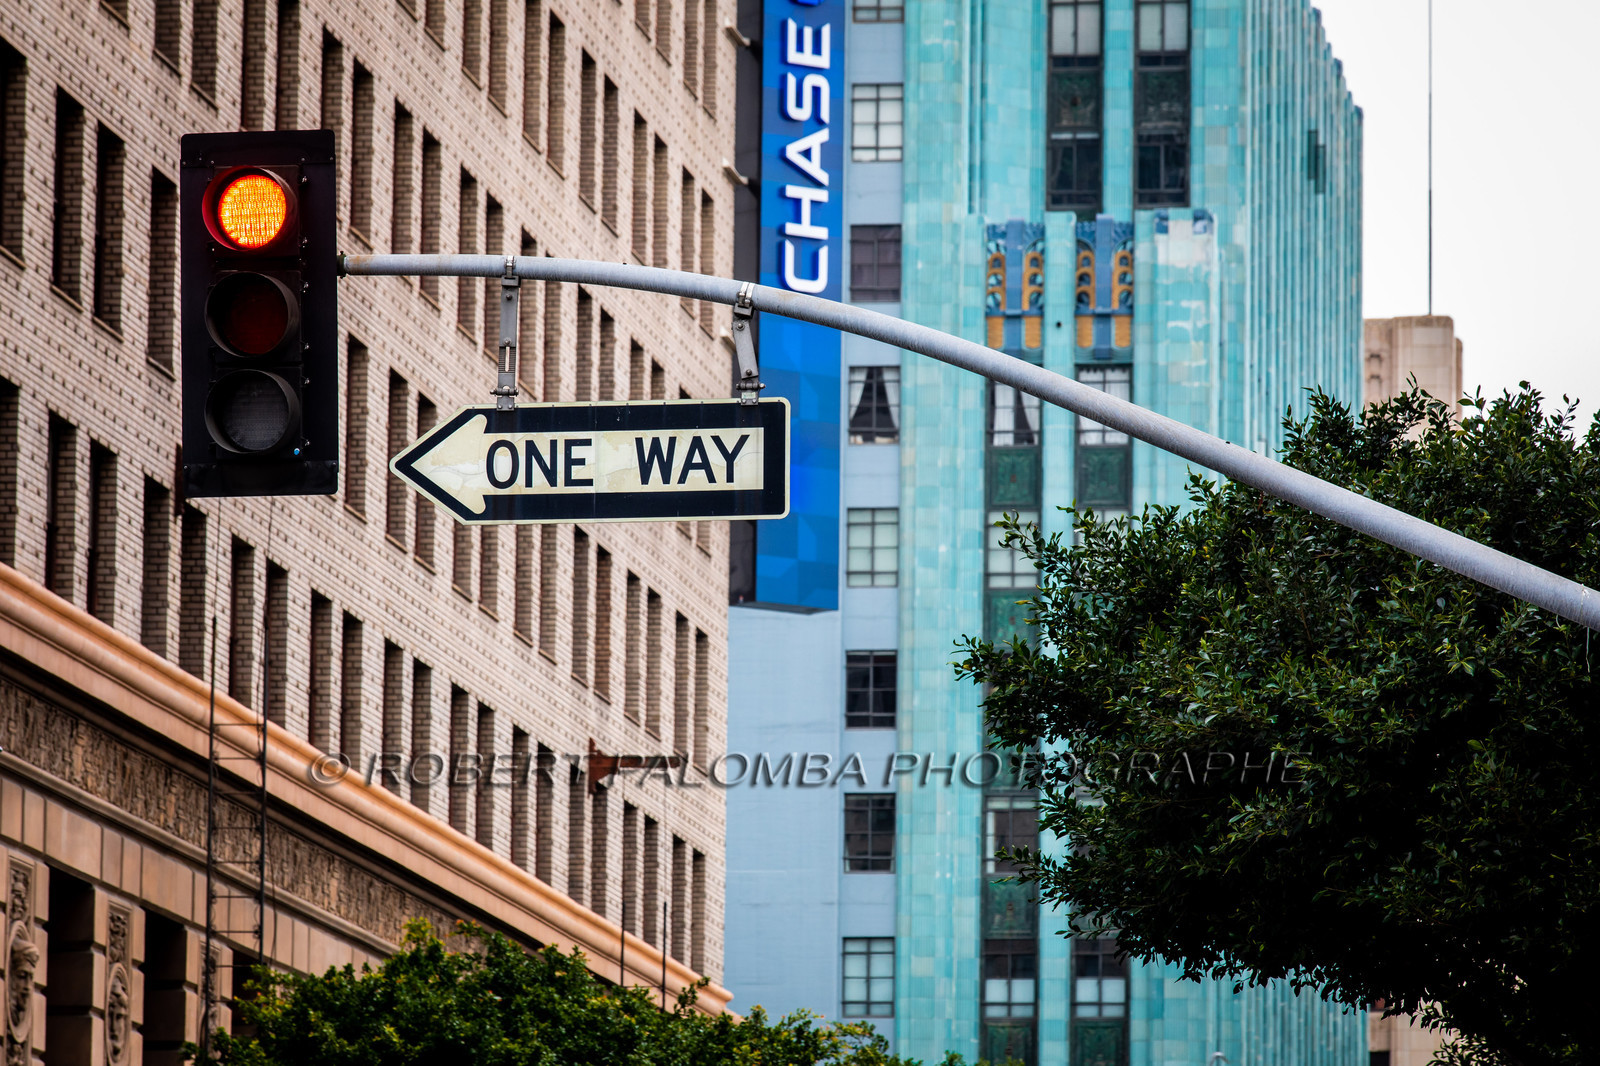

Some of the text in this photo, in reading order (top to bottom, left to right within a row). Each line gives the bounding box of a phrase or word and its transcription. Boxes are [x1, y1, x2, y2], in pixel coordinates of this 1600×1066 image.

[785, 17, 831, 293] CHASE
[486, 434, 751, 489] ONE WAY
